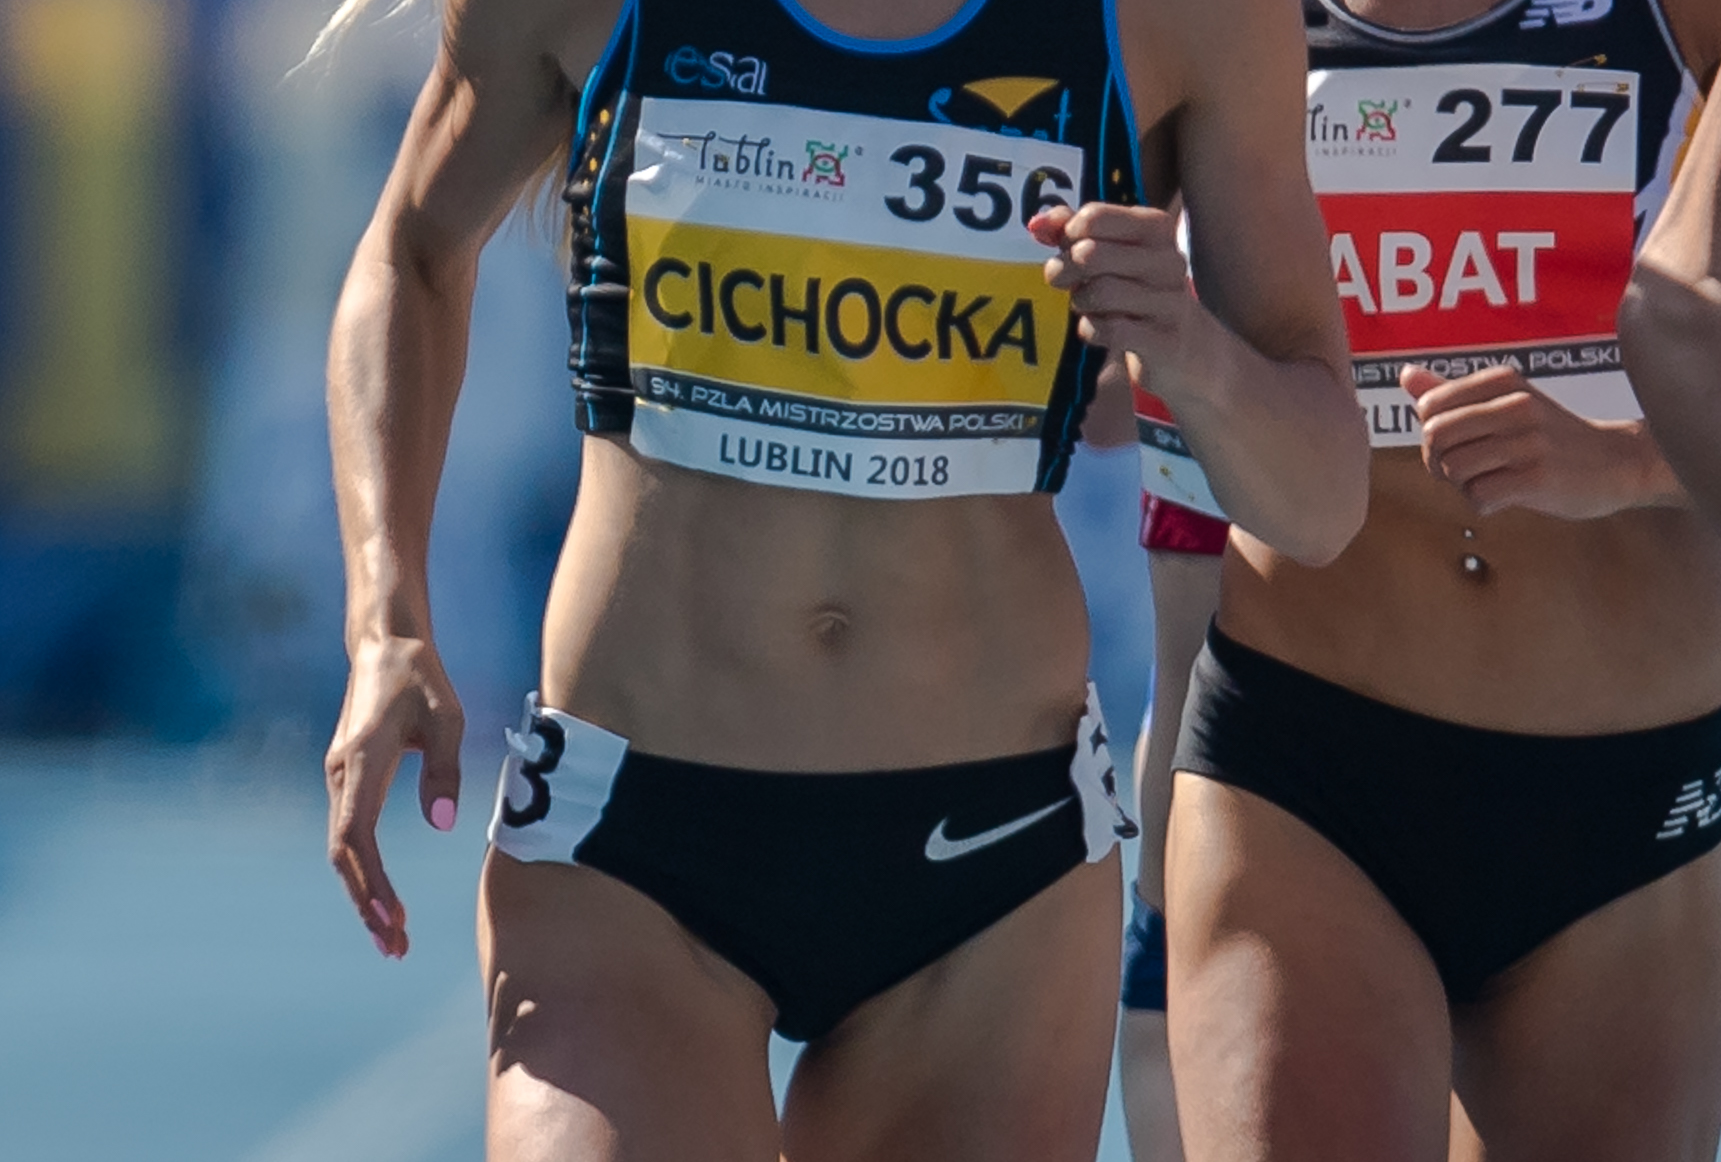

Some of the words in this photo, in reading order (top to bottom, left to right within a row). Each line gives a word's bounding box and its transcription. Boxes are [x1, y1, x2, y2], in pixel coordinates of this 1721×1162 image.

[664, 46, 767, 95] esa
[1432, 88, 1630, 165] 277
[884, 143, 1074, 232] 356
[643, 257, 1039, 366] CICHOCKA
[1330, 231, 1555, 316] ABAT
[1530, 347, 1620, 372] POLSKI
[691, 386, 753, 414] PZLA
[759, 401, 944, 432] MISTRZOSTWA
[949, 413, 1023, 432] POLSKI
[720, 433, 852, 482] LUBLIN
[867, 455, 949, 487] 2018
[501, 716, 566, 827] 3
